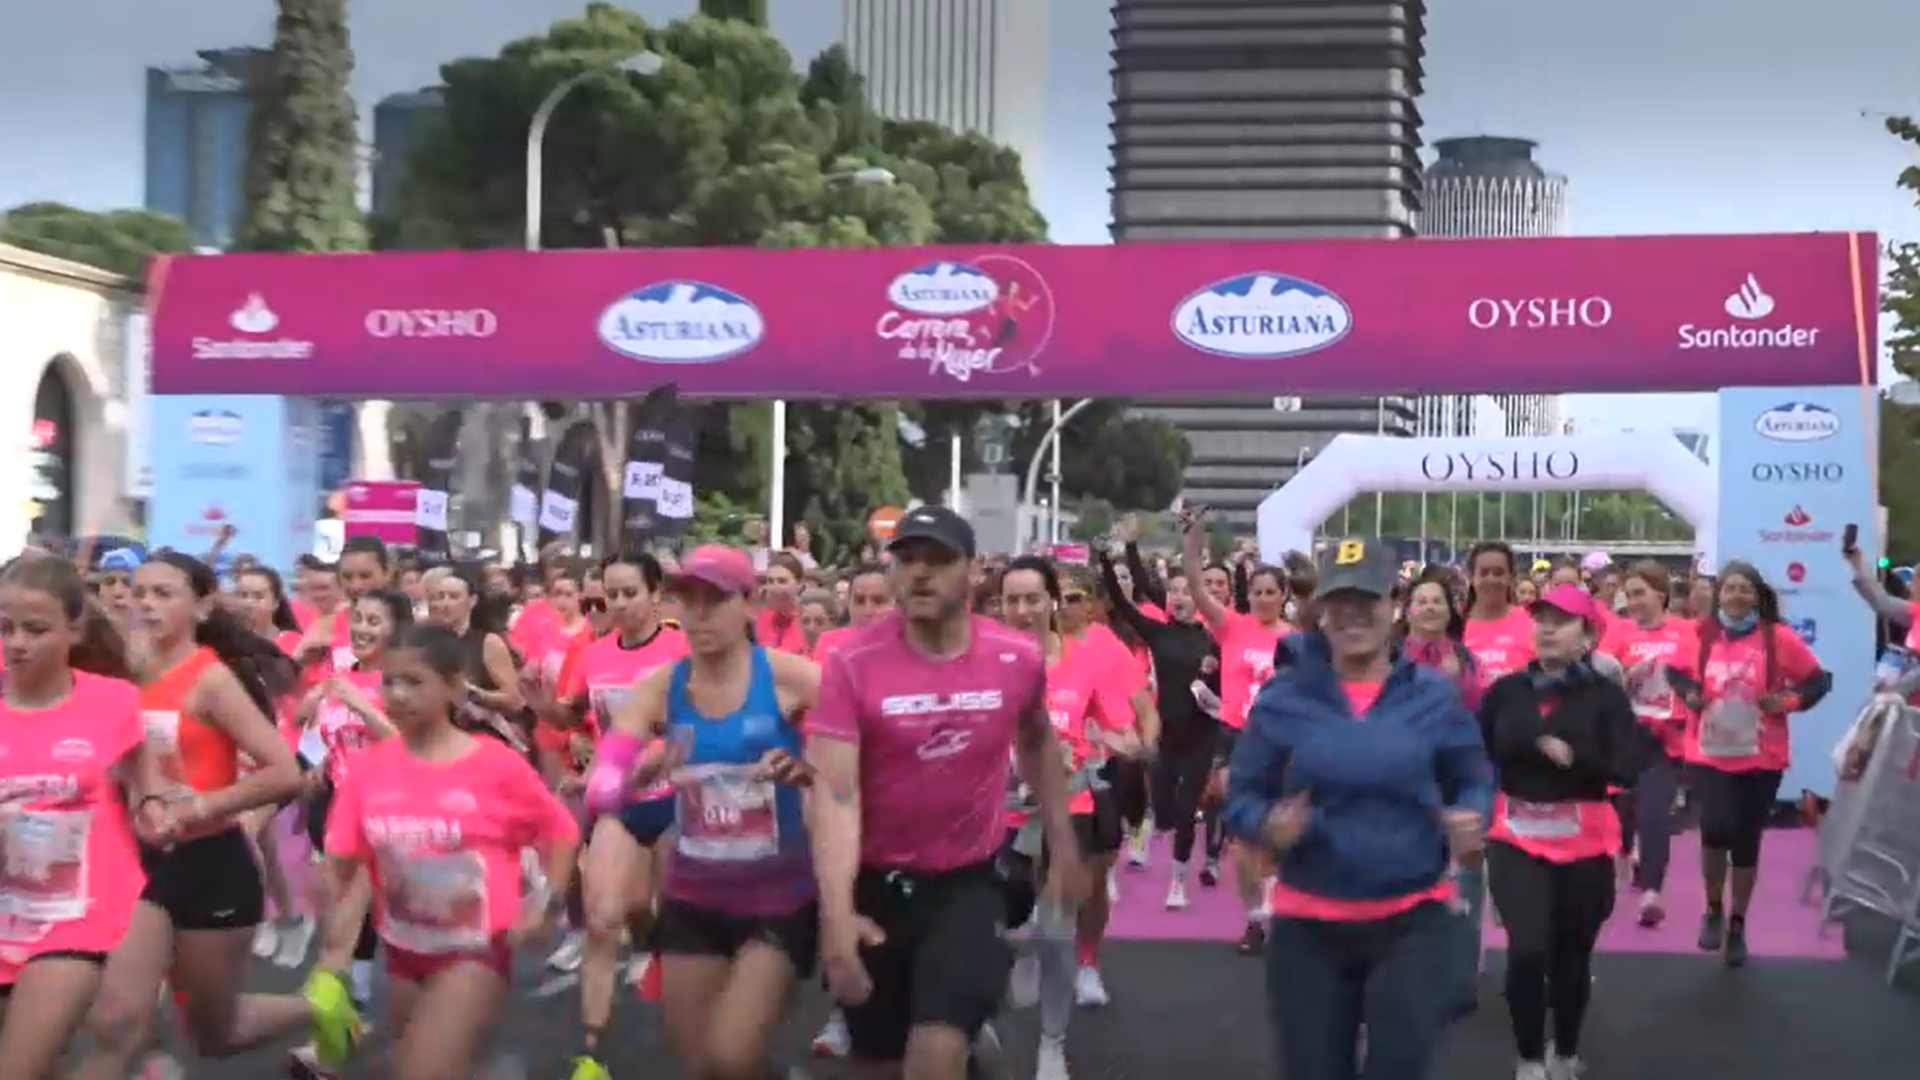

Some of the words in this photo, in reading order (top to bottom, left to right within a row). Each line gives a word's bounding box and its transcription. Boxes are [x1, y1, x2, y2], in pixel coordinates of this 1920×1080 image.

[364, 309, 498, 338] OYSHO
[1187, 305, 1338, 336] ASTURIANA
[1467, 296, 1613, 328] OYSHO
[609, 315, 754, 341] ASTURIANA
[1678, 323, 1820, 350] Santander
[1422, 450, 1579, 482] OYSHO
[1752, 462, 1844, 483] OYSHO
